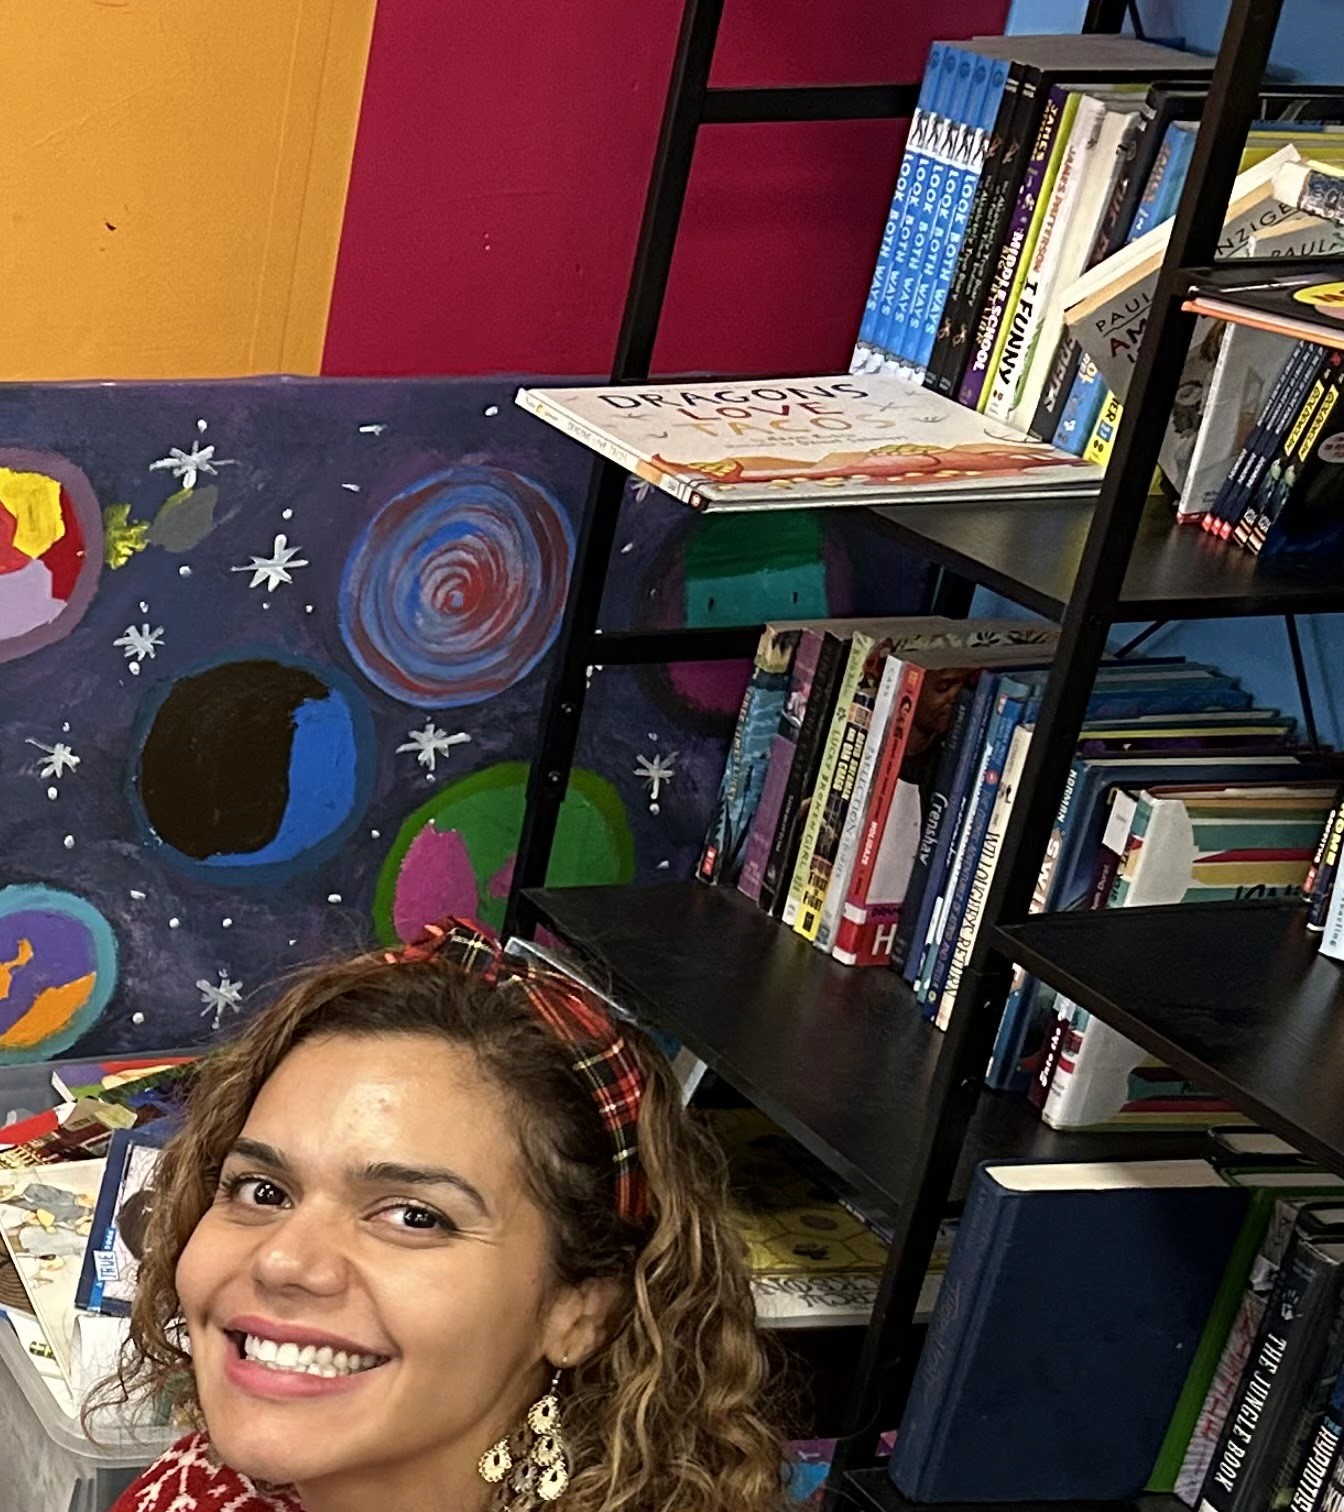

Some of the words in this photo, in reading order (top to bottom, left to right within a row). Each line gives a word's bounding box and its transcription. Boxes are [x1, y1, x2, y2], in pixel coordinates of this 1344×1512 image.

[1036, 104, 1057, 161] JAMES
[893, 154, 914, 202] LOOK
[910, 158, 929, 207] LOOK
[923, 164, 944, 214] LOOK
[1057, 144, 1076, 193] JAMES
[939, 169, 959, 220] LOOK
[955, 175, 976, 224] LOOK
[880, 209, 900, 258] BOTH
[895, 215, 915, 263] BOTH
[909, 221, 929, 269] BOTH
[924, 226, 944, 276] BOTH
[1033, 194, 1060, 273] PATTERSON
[1216, 202, 1293, 255] NZIGE
[940, 232, 961, 281] BOTH
[867, 265, 886, 311] WAYS
[882, 270, 900, 315] WAYS
[895, 277, 913, 322] WAYS
[910, 283, 929, 329] WAYS
[925, 289, 946, 335] WAYS
[967, 280, 980, 307] Diary
[1023, 278, 1038, 298] I
[974, 305, 999, 372] SCHOOL
[998, 299, 1032, 385] FUNNY
[598, 383, 870, 409] DRAGONS
[678, 401, 844, 421] LOVE
[672, 414, 897, 436] TACOS
[730, 726, 746, 762] TIMES
[824, 730, 840, 771] LUCKY
[840, 742, 852, 762] DAN
[726, 765, 740, 800] LUCKY
[809, 774, 828, 831] BROKEN
[841, 758, 858, 800] SHERMAN
[846, 754, 871, 833] SELECTION
[1055, 769, 1078, 822] KORMAN
[798, 833, 814, 869] GIRL
[915, 792, 948, 866] Crenshaw
[961, 831, 998, 930] WILLOUGHBYS
[942, 936, 970, 997] RETURN
[1050, 1027, 1061, 1047] the
[96, 1251, 118, 1279] TRUE
[1256, 1332, 1286, 1374] THE
[1231, 1370, 1272, 1442] JUNGLE
[1212, 1439, 1246, 1492] BOOK
